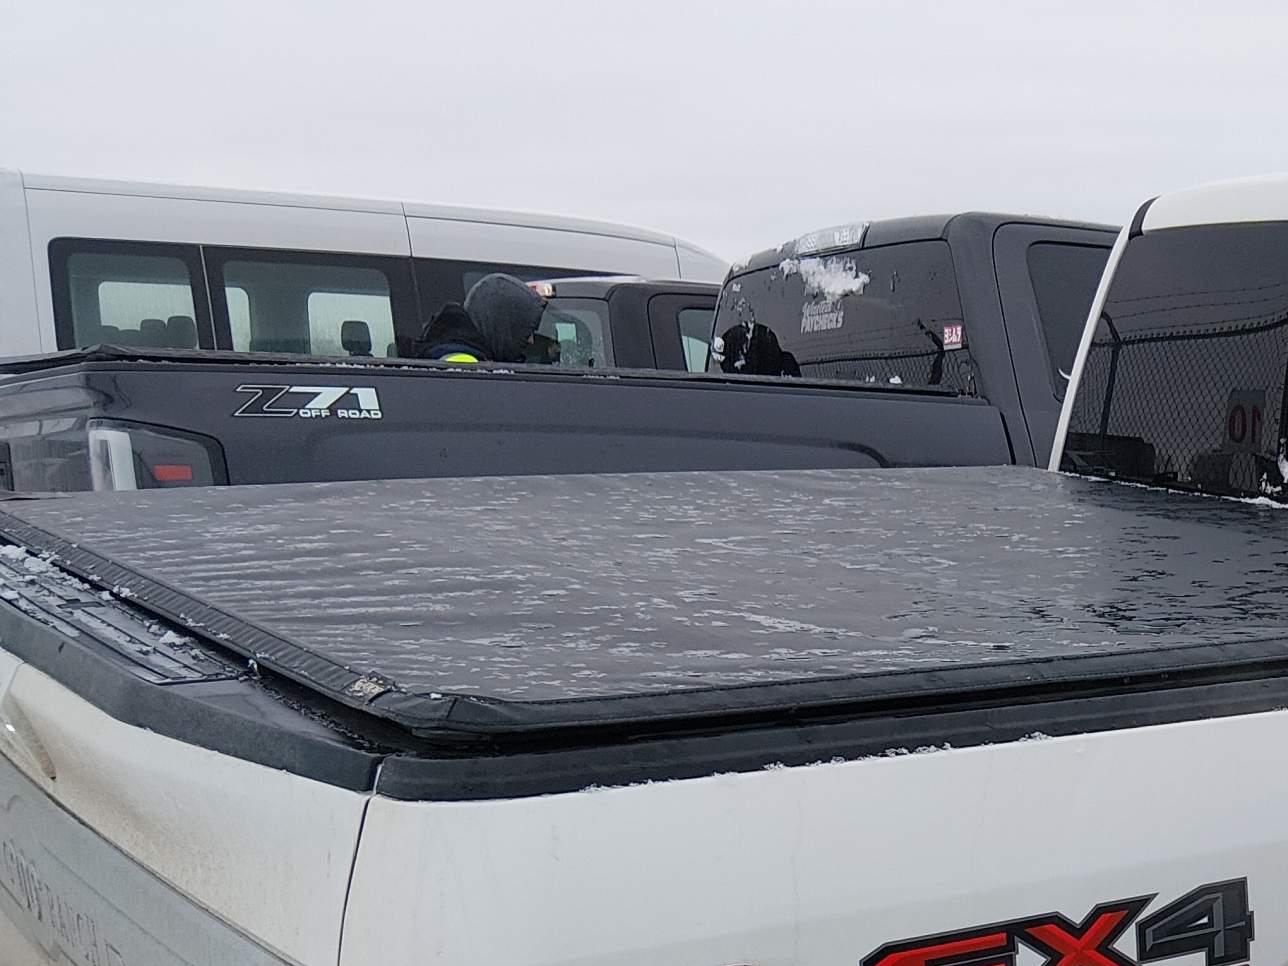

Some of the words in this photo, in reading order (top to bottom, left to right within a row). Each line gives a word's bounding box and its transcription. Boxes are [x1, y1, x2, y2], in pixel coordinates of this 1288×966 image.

[234, 385, 380, 416] Z71
[299, 409, 330, 418] OFF
[337, 409, 382, 419] ROAD
